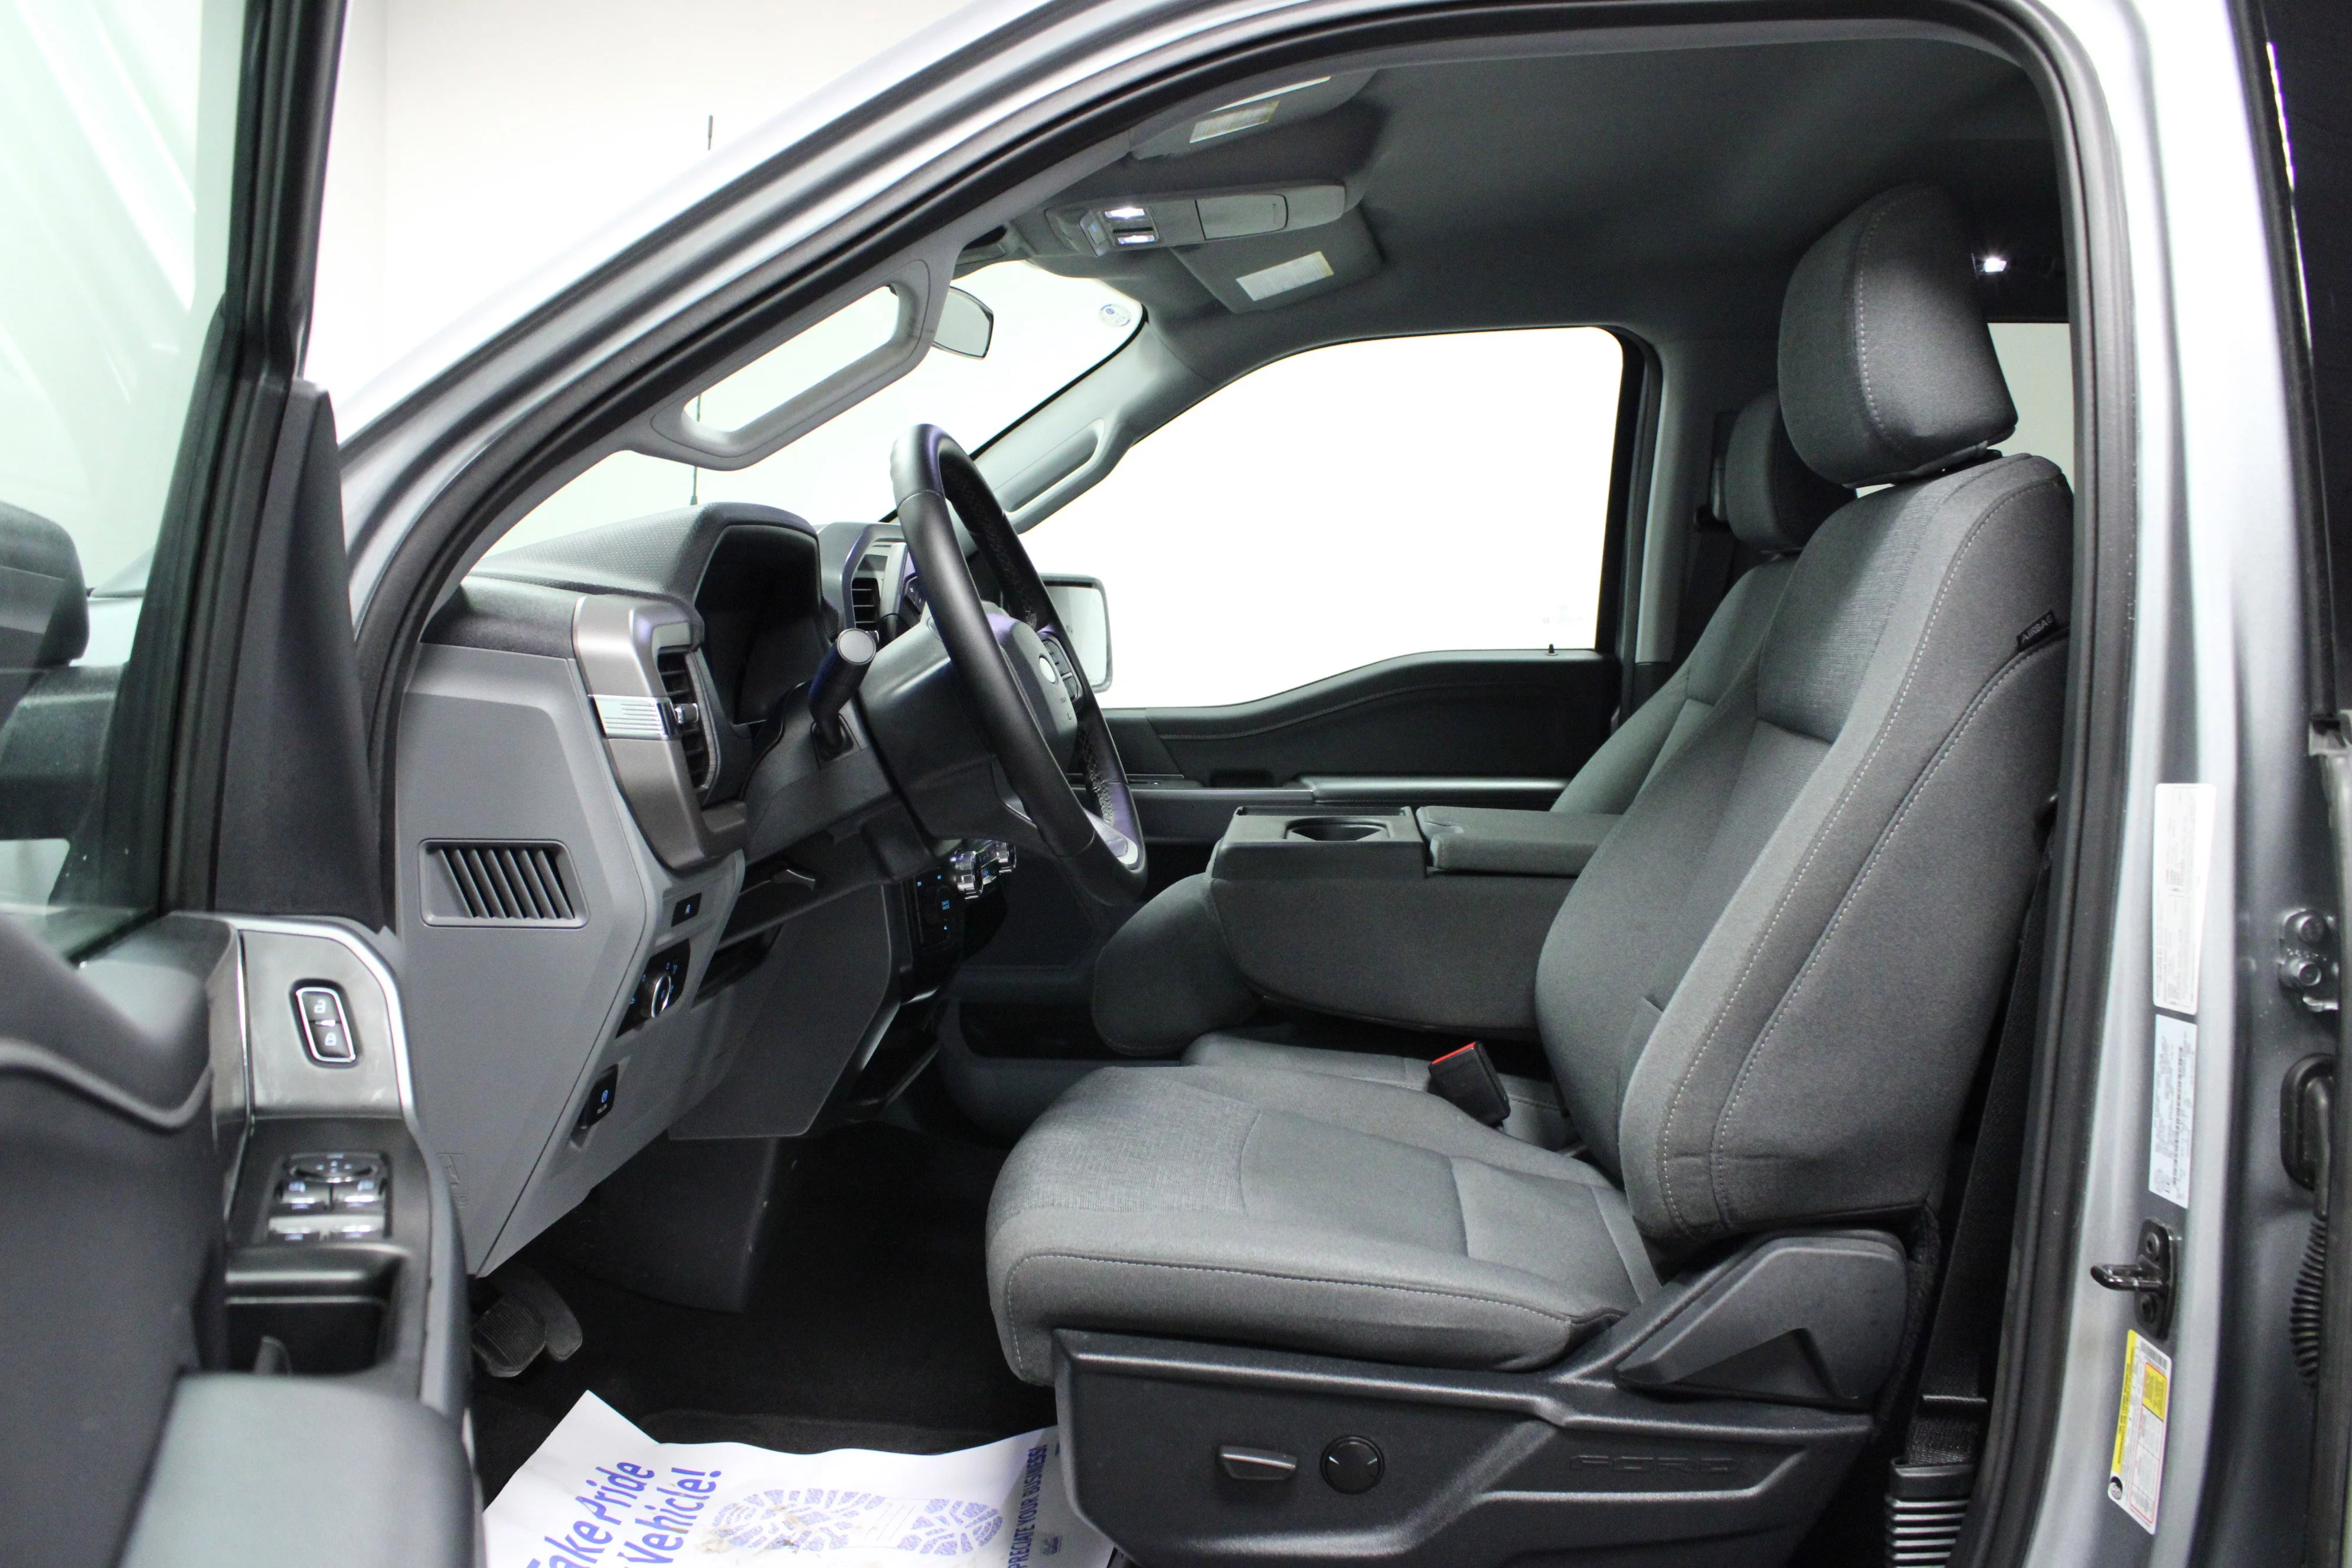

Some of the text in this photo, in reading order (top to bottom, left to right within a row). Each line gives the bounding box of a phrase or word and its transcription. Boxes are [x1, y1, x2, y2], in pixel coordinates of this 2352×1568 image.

[2021, 614, 2053, 644] AIRBAG
[1023, 1444, 1048, 1497] BUSINESS!
[1570, 1454, 1737, 1472] FORD
[576, 1462, 655, 1525] Pride
[1018, 1495, 1039, 1526] YOUR
[617, 1467, 722, 1563] Vehicle!
